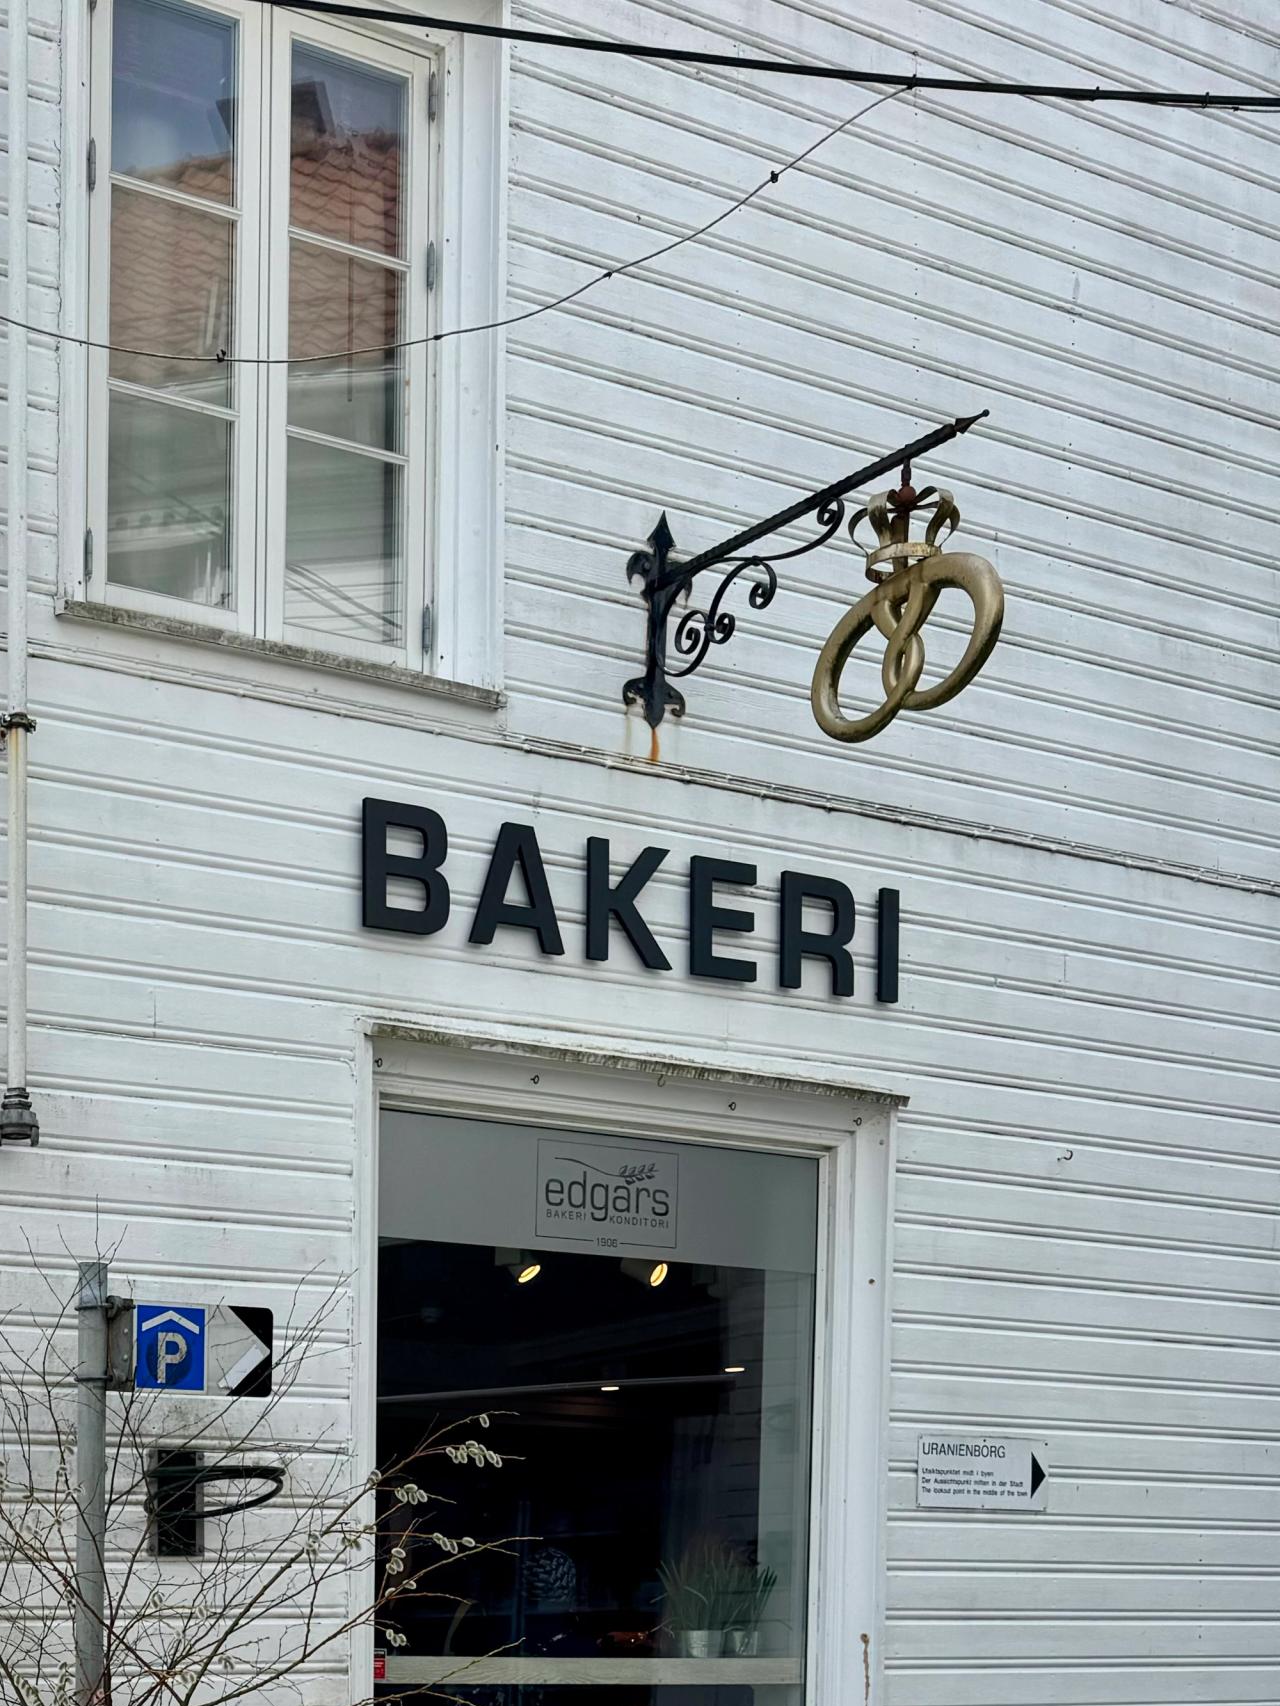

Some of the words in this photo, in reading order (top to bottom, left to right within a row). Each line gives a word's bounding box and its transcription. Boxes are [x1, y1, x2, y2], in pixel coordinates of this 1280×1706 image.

[362, 797, 900, 1004] BAKERI
[545, 1171, 670, 1222] edgars
[546, 1208, 587, 1221] BAKERI
[609, 1215, 669, 1229] KONDITORI
[156, 1331, 186, 1384] P
[922, 1442, 1006, 1459] URANIENBORG
